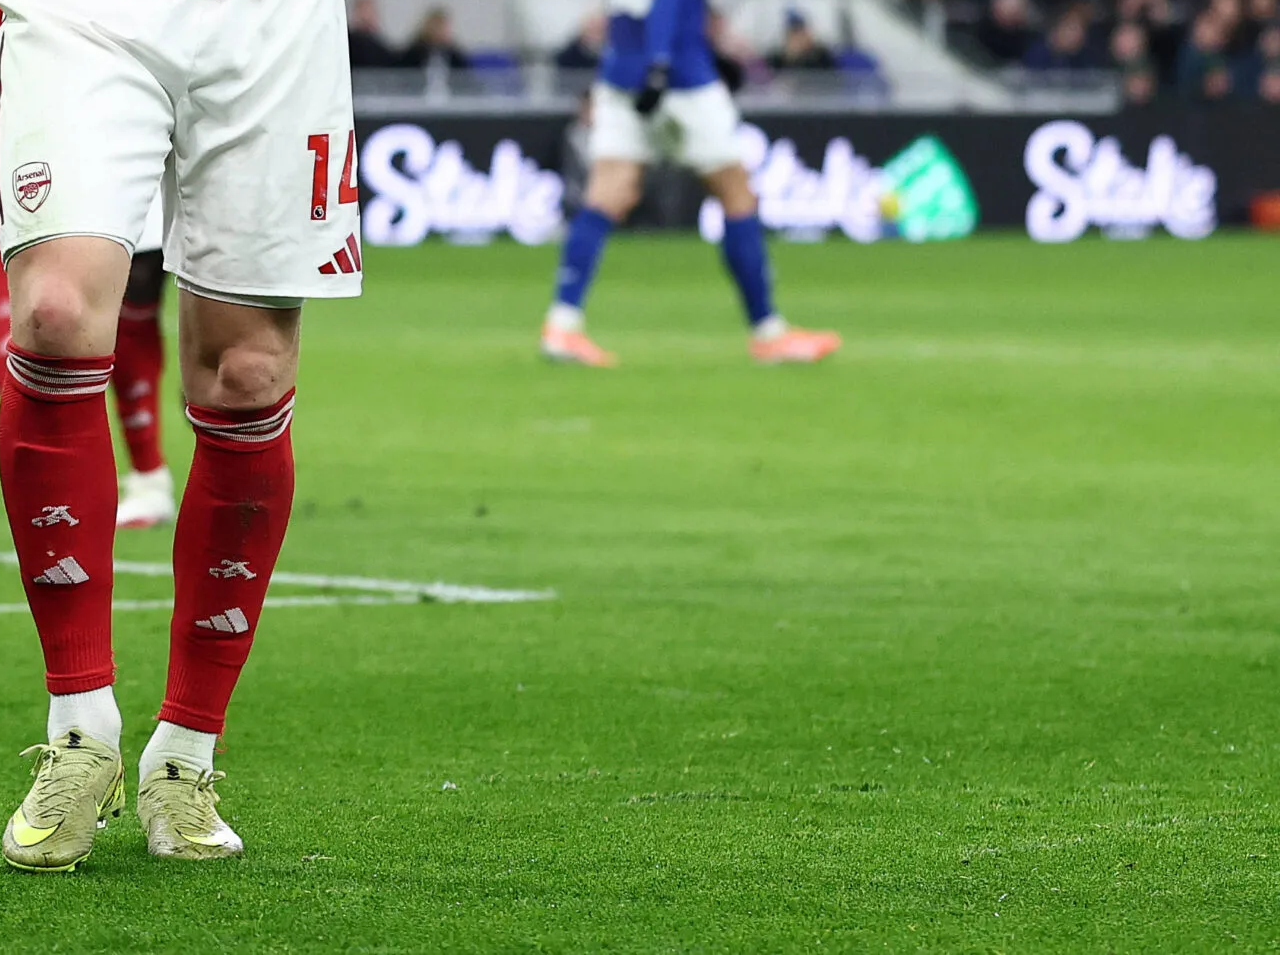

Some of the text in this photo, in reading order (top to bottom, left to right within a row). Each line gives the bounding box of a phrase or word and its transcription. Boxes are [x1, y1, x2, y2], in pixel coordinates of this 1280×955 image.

[17, 169, 45, 182] Arsenal
[361, 123, 565, 245] Stake
[1024, 119, 1217, 243] Stake
